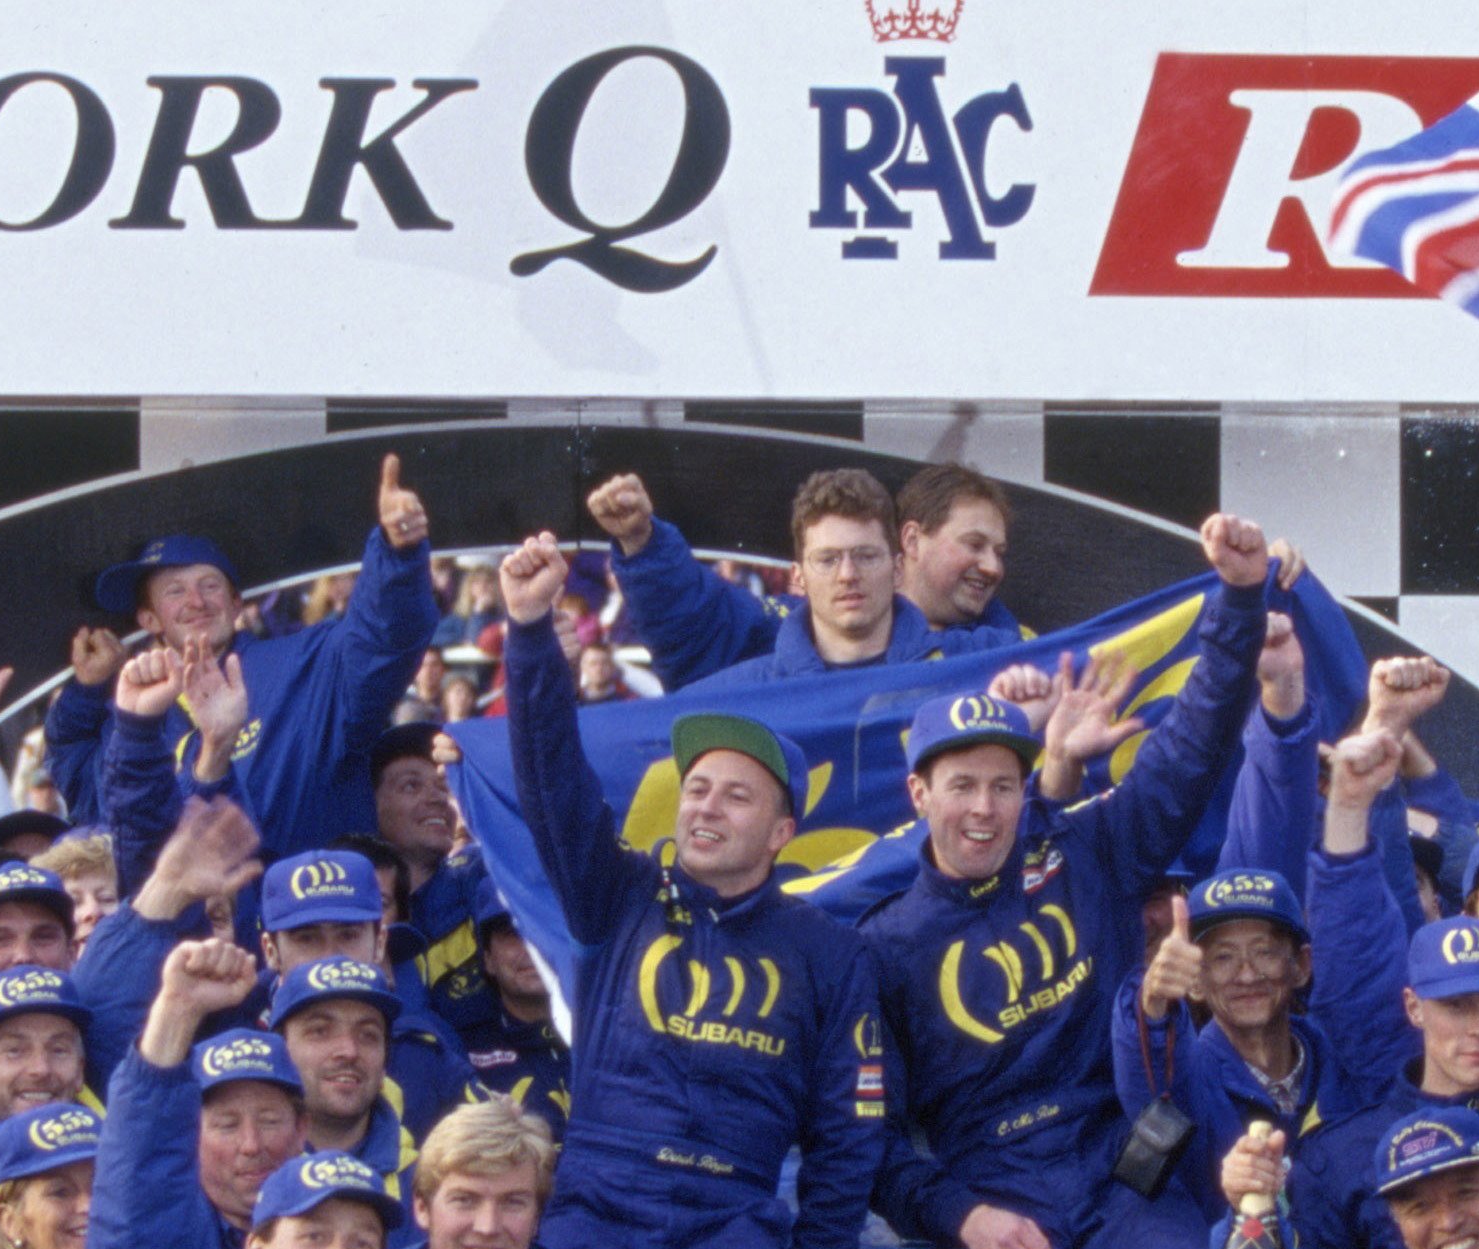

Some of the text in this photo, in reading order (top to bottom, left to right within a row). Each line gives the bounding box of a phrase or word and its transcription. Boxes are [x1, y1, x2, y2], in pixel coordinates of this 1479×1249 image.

[510, 45, 731, 294] Q
[808, 56, 1037, 260] RAC
[1217, 875, 1274, 898] 555
[998, 957, 1094, 1030] SUBARU
[667, 1016, 786, 1057] SUBARU
